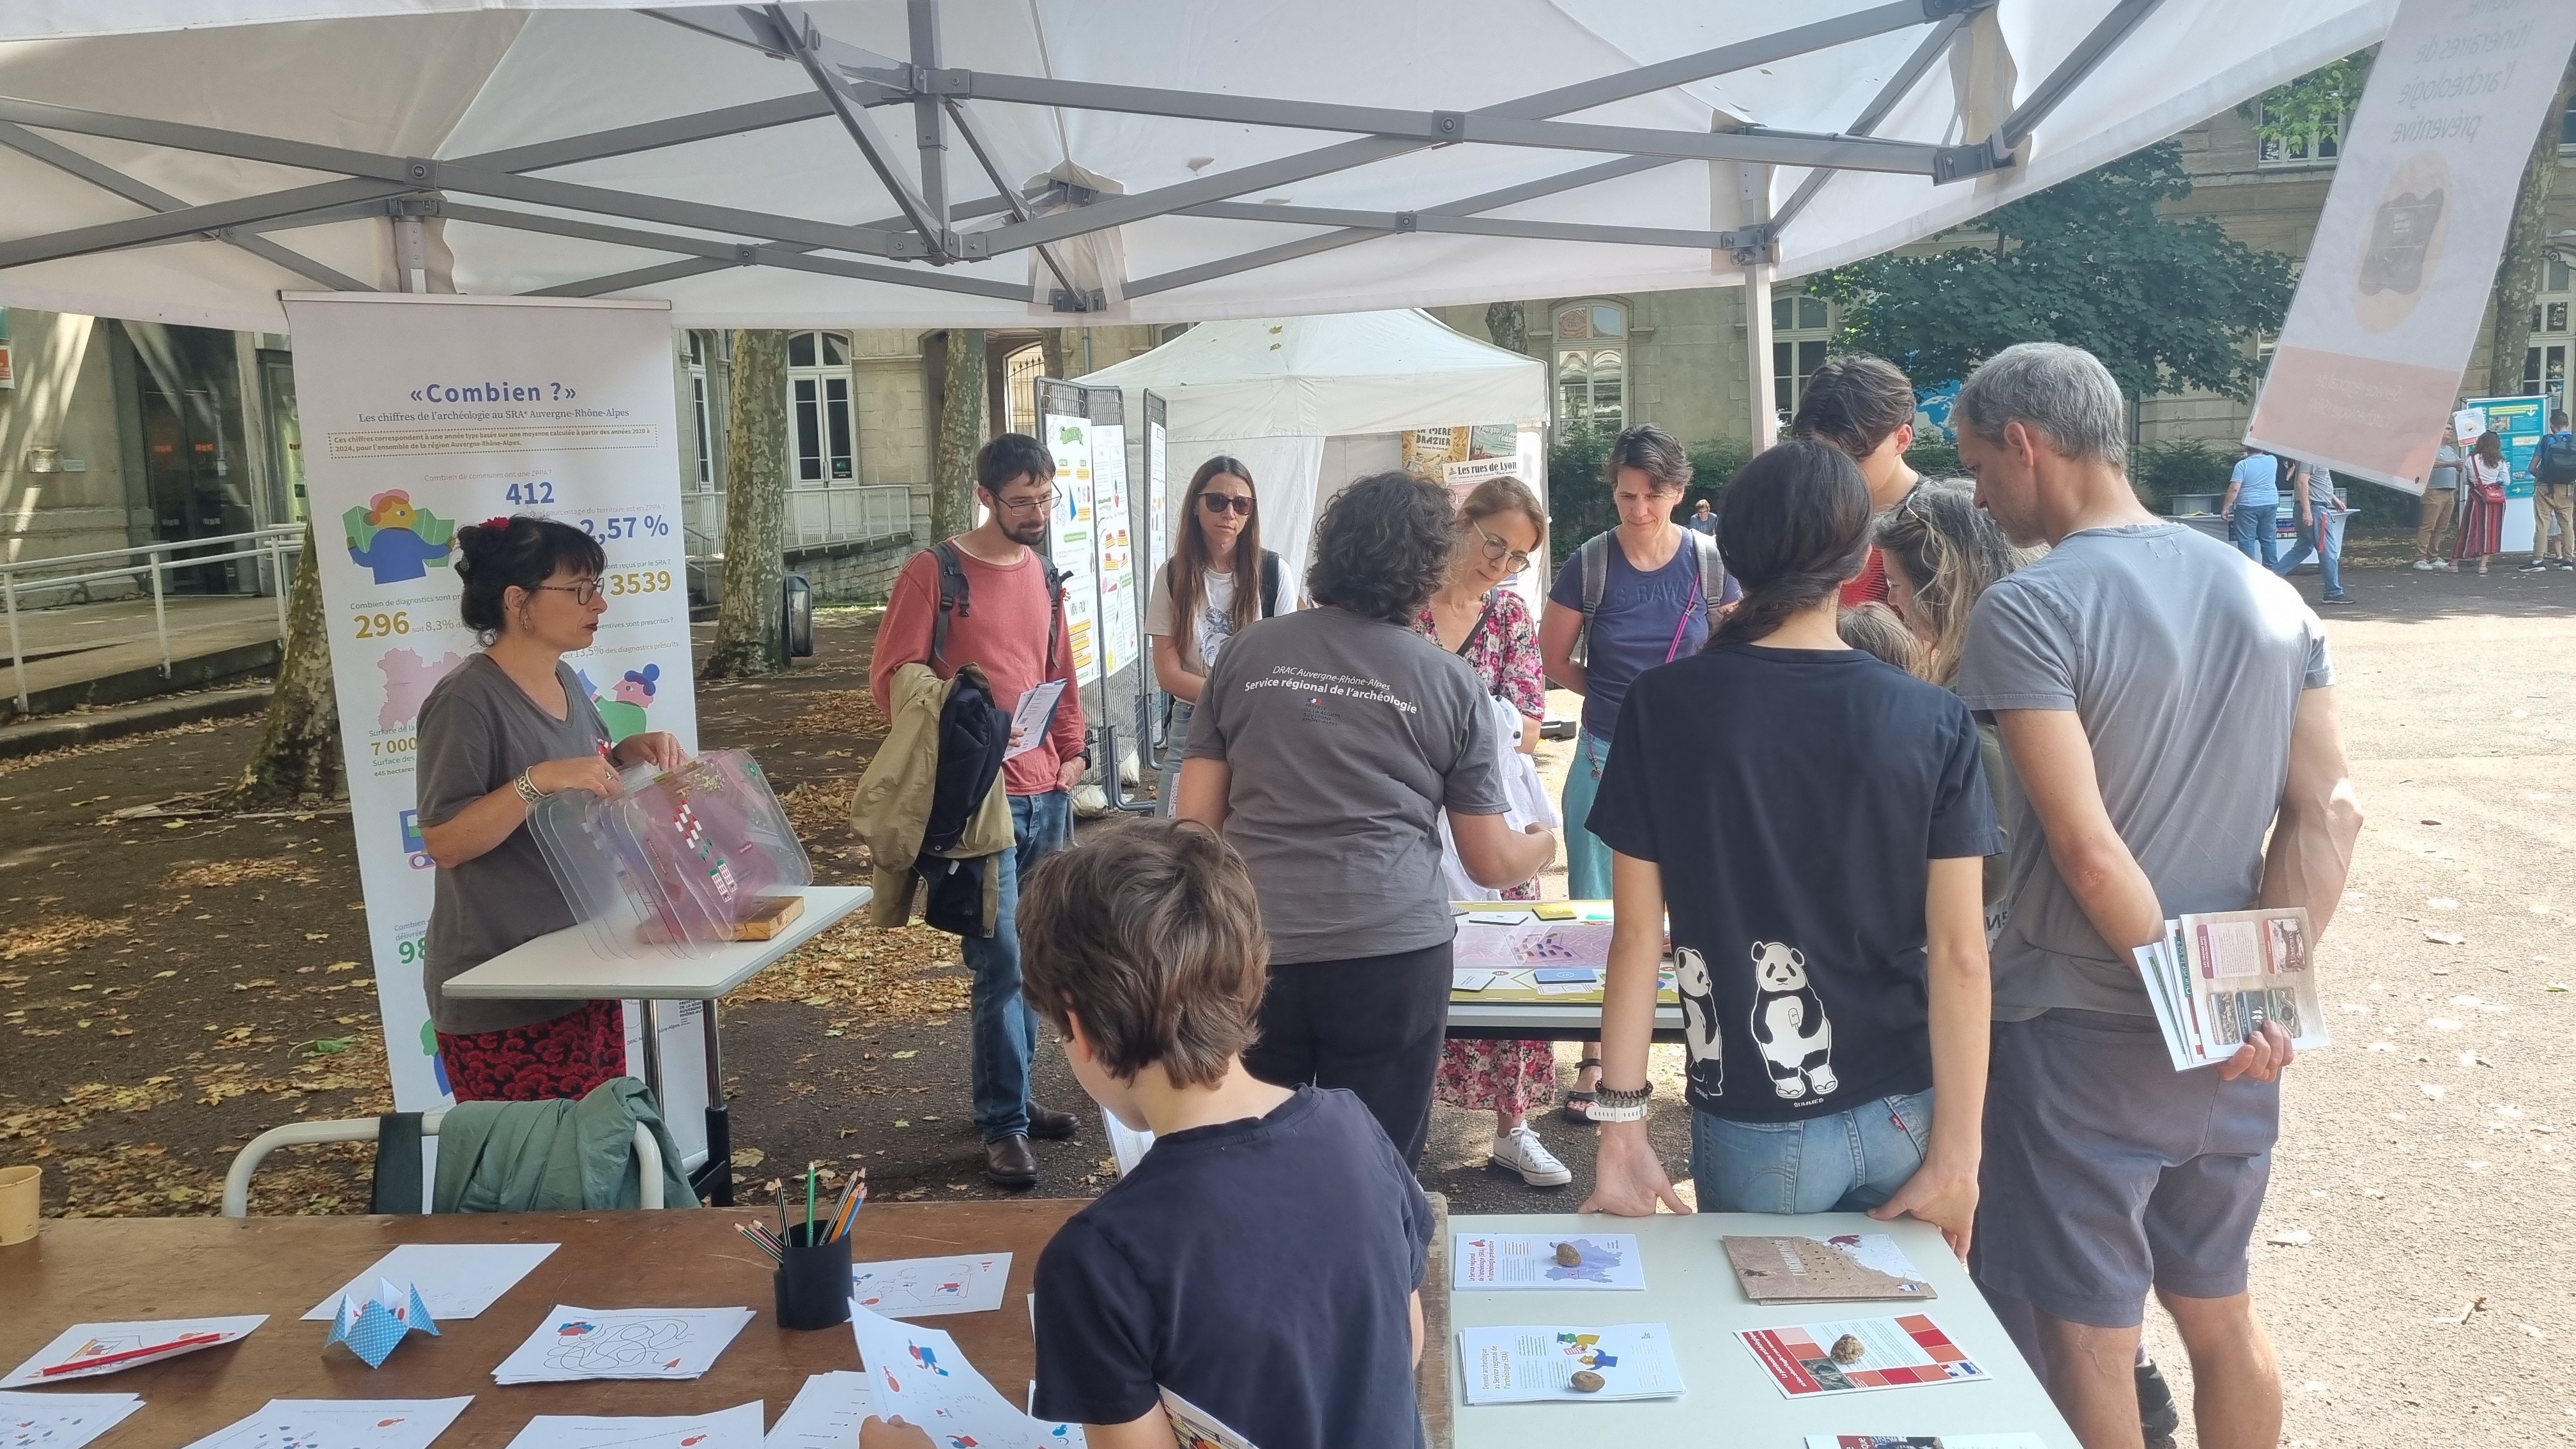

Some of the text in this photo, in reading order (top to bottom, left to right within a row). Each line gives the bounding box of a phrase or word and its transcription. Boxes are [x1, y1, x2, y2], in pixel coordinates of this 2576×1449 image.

[358, 414, 376, 422] Les
[378, 412, 415, 422] chiffres
[417, 411, 430, 420] de
[431, 411, 491, 421] l'archéologie
[530, 408, 629, 420] Auvergne-Rhône-Alpes
[374, 433, 424, 443] correspondent
[1416, 434, 1450, 446] BRAZIER
[427, 441, 450, 450] région
[1458, 461, 1517, 475] Les rues de Lyon
[505, 482, 555, 505] 412
[643, 514, 669, 537] %
[610, 571, 671, 596] 3539
[350, 601, 384, 610] Combien
[395, 596, 434, 606] diagnostics
[353, 611, 410, 639] 296
[425, 619, 454, 632] 8,3%
[640, 618, 670, 627] prescrites
[618, 645, 654, 654] diagnostics
[1273, 666, 1392, 691] DRAC Auvergne-Rhône-Alpes
[1245, 678, 1418, 714] Service régional de l'archéologie
[369, 728, 396, 737] Surface
[372, 757, 401, 767] Surface
[387, 767, 415, 775] hectares
[394, 920, 426, 931] Combien
[1794, 1098, 1824, 1108] SUMMER
[1490, 1352, 1500, 1368] régional
